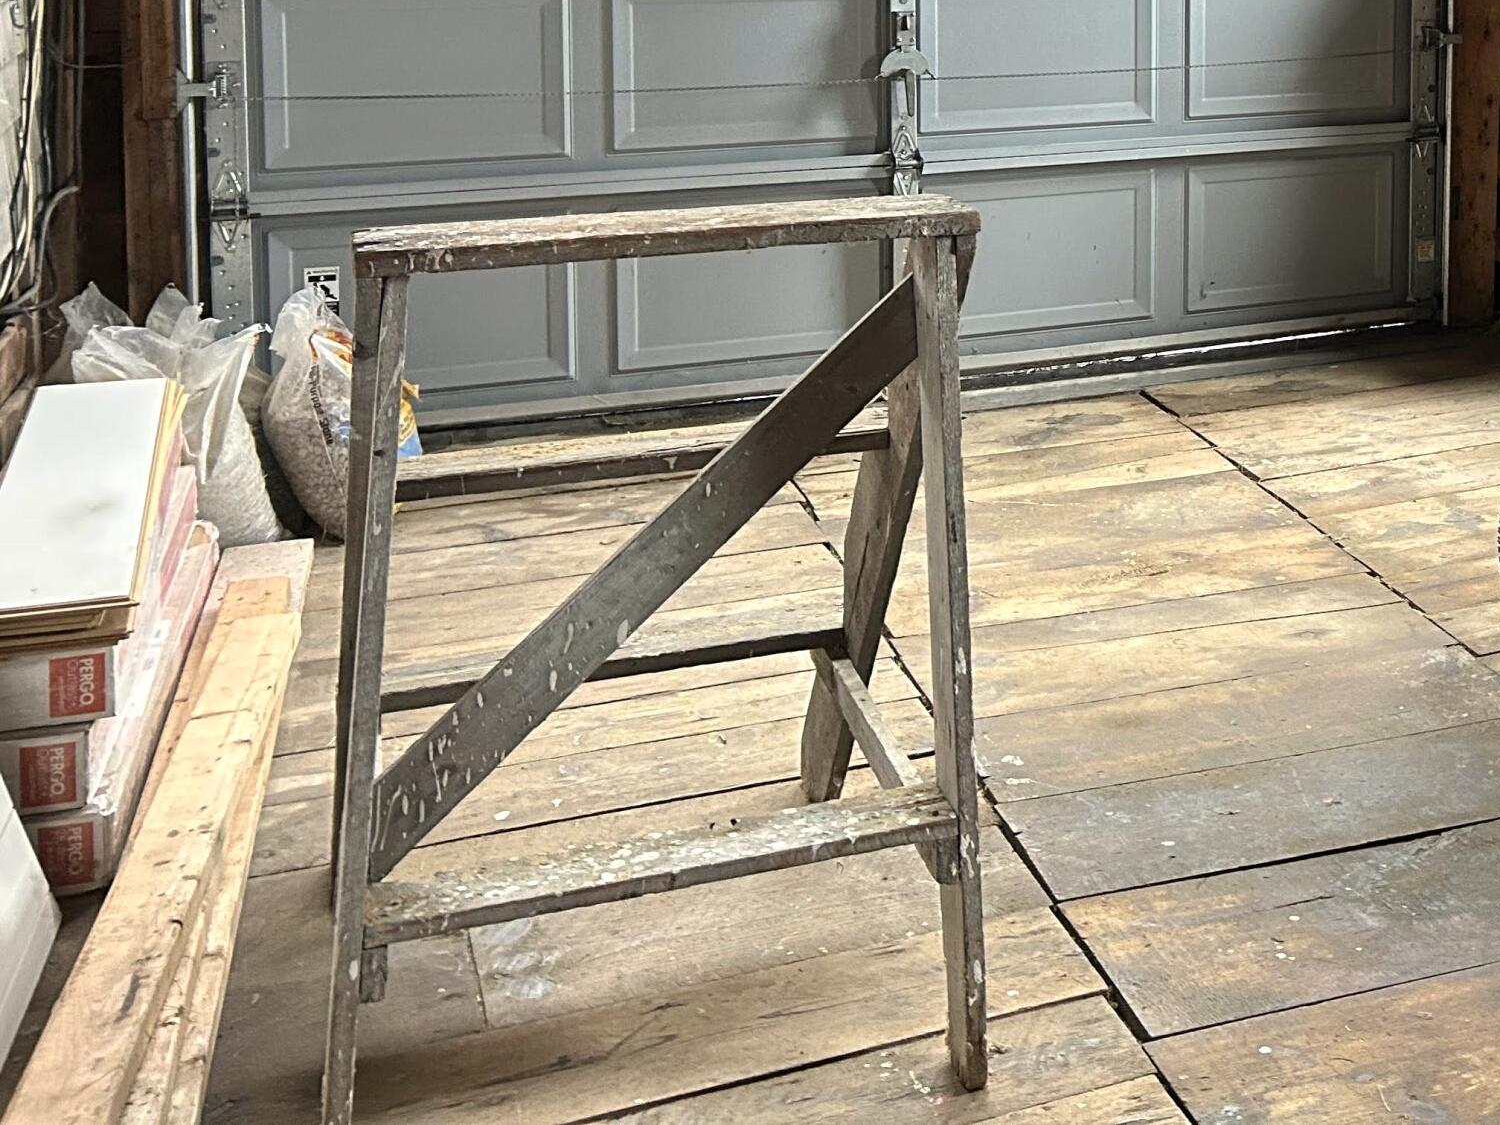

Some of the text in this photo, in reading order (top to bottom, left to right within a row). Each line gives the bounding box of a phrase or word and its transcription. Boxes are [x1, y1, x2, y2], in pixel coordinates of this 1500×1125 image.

[79, 657, 95, 706] PERGO
[50, 746, 65, 796] PERGO
[67, 826, 83, 875] PERGO
